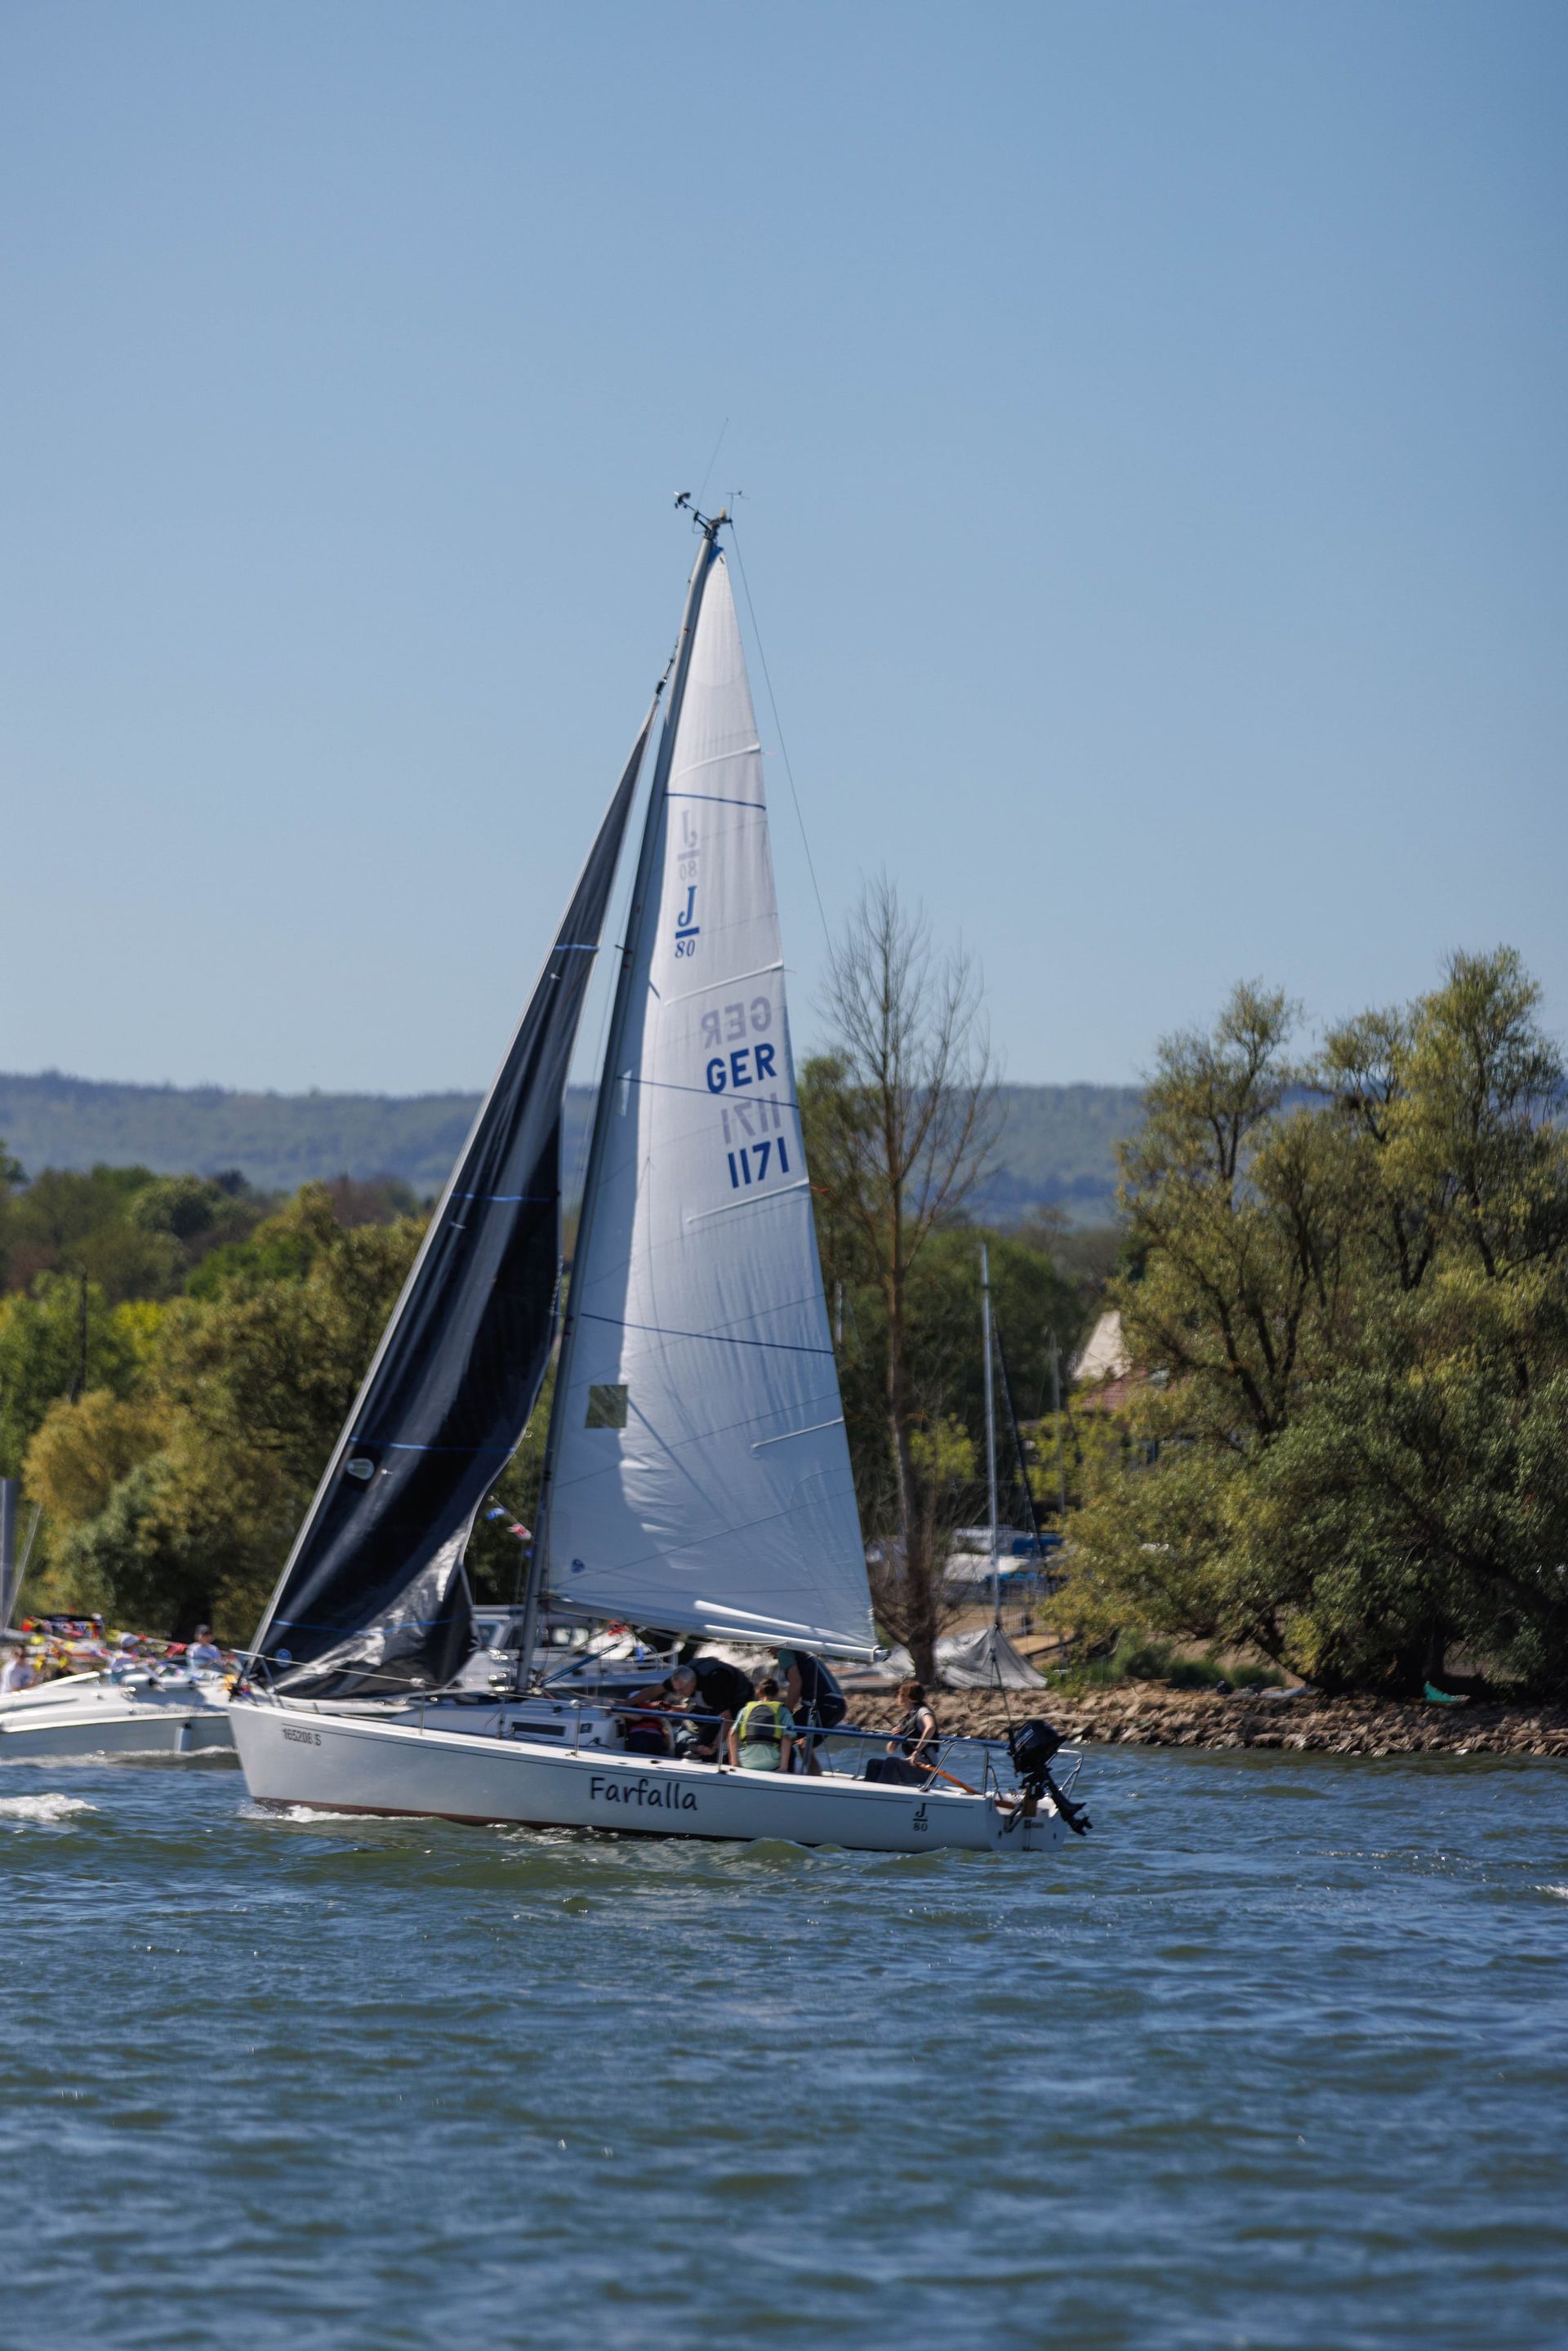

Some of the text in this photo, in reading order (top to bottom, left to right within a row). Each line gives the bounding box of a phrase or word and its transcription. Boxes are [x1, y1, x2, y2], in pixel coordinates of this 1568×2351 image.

[677, 884, 697, 928] J
[675, 939, 696, 959] 80
[706, 1042, 777, 1094] GER
[727, 1136, 790, 1189] 1171
[590, 1776, 698, 1810] Farfalla
[915, 1802, 927, 1818] J
[913, 1822, 928, 1832] 80
